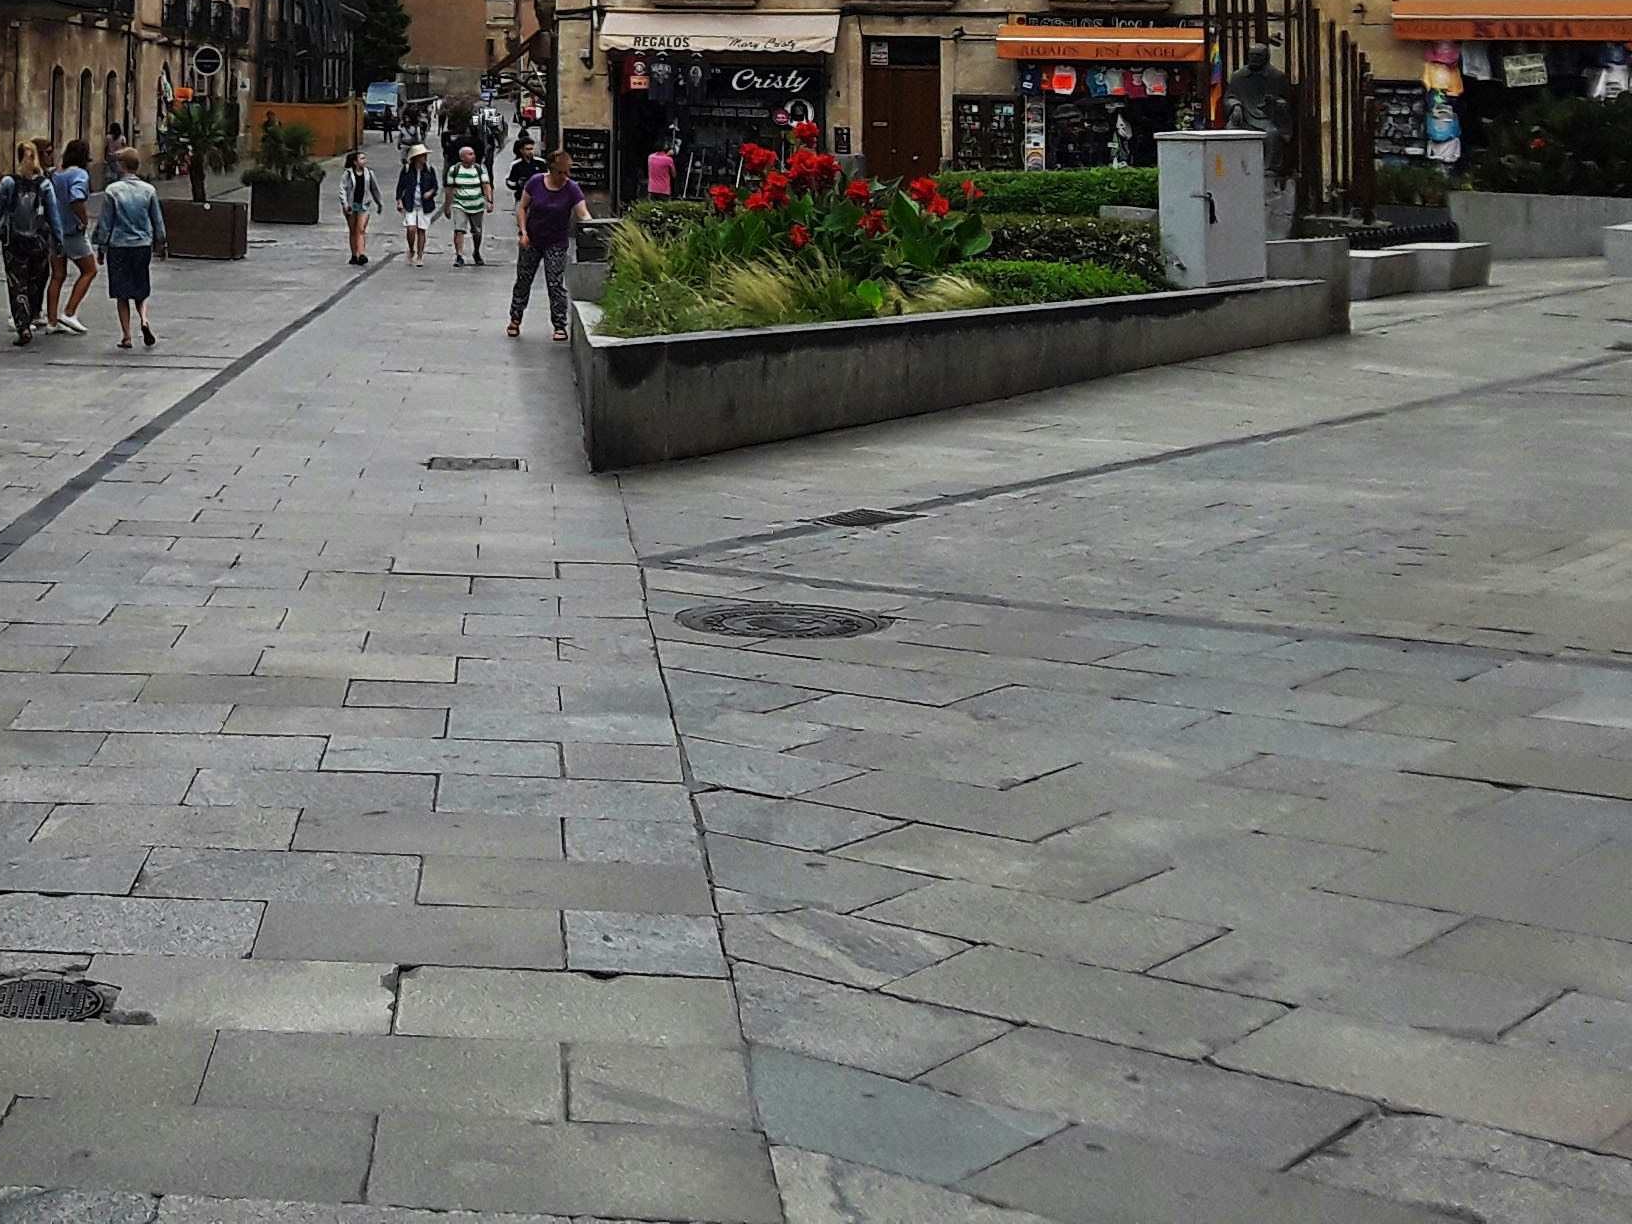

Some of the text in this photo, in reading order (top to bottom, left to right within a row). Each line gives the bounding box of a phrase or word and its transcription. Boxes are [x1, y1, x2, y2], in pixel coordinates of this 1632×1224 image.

[1473, 21, 1572, 38] KARMA
[633, 36, 690, 48] REGALOS
[732, 68, 810, 93] Cristy
